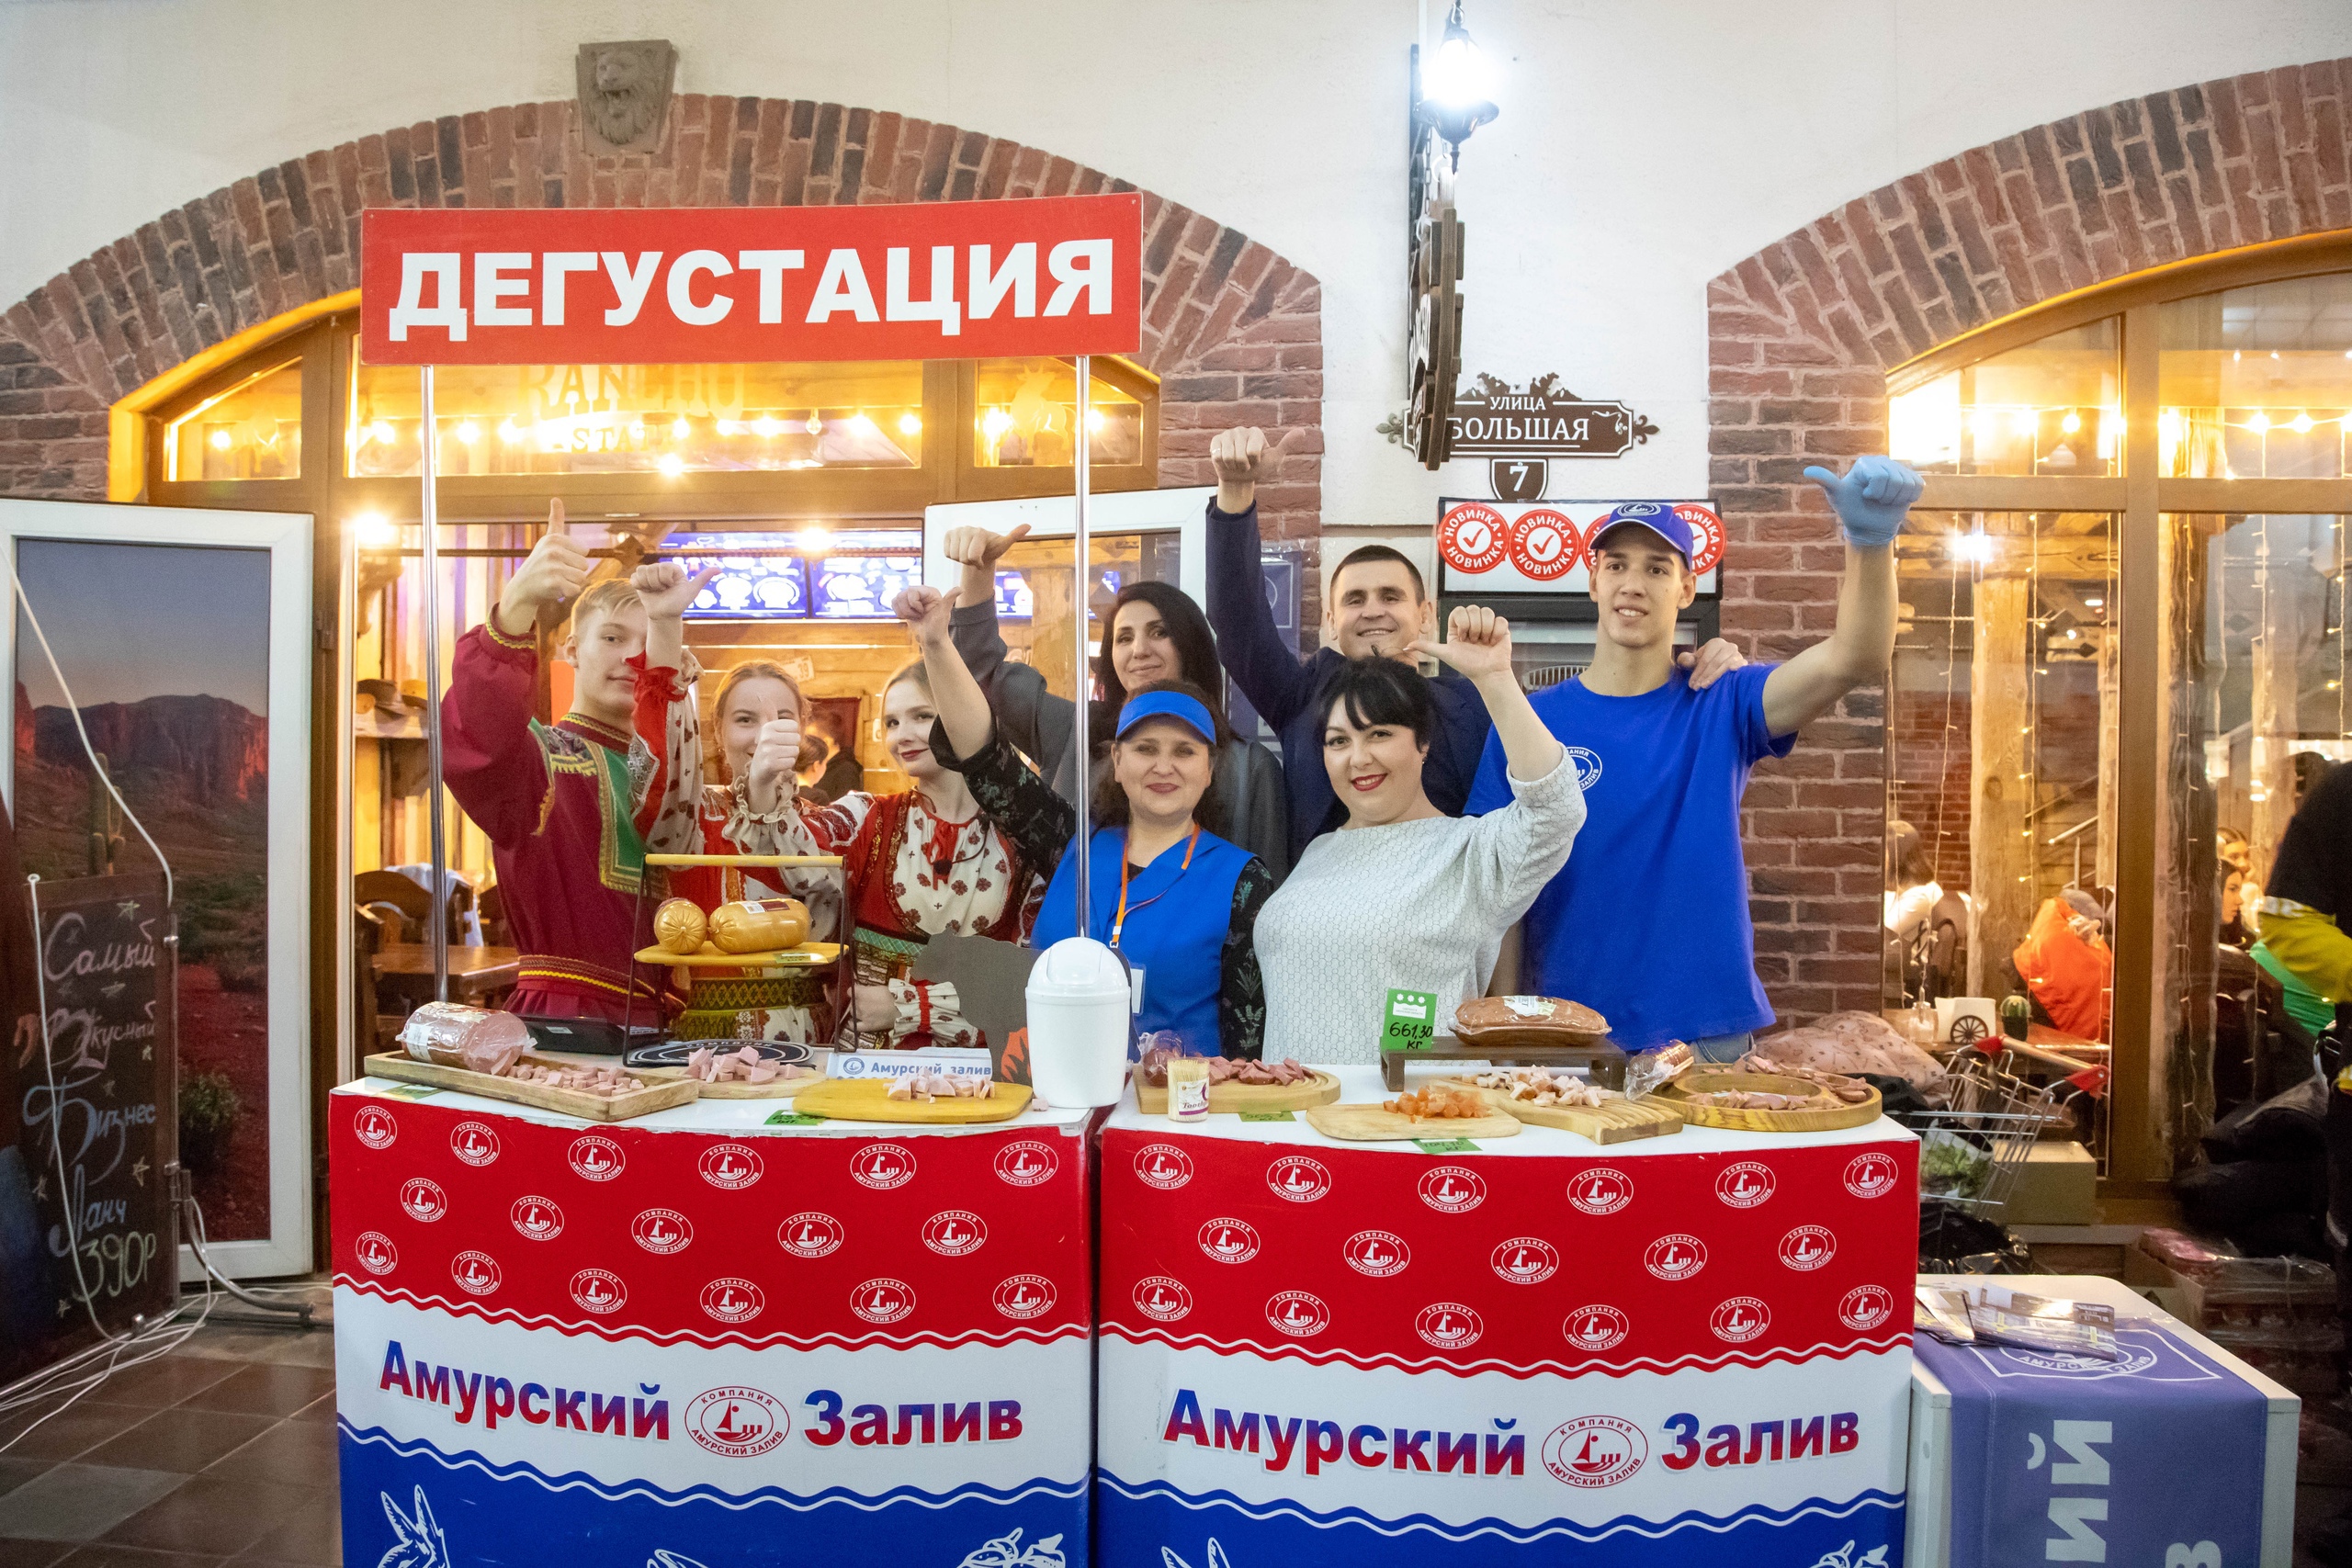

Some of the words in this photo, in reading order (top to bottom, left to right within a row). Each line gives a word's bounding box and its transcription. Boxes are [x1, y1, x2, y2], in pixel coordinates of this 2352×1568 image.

[389, 237, 1113, 343] ДЕГУСТАЦИЯ
[1489, 396, 1546, 412] УЛИЦА
[1451, 417, 1589, 441] БОЛЬШАЯ
[1509, 466, 1529, 492] 7
[1444, 509, 1500, 537] НОВИНКА
[1514, 514, 1571, 543] НОВИНКА
[1675, 510, 1720, 544] ОВИНКА
[1446, 540, 1504, 569] НОВИНКА
[1516, 547, 1574, 575] НОВИНКА
[1579, 769, 1600, 788] ЗАЛИВ
[44, 912, 156, 982] Самый
[950, 1066, 991, 1075] залив
[23, 1073, 157, 1186] Бизнес
[458, 1123, 492, 1137] КОМПАНИЯ
[577, 1137, 616, 1151] КОМПАНИЯ
[708, 1145, 753, 1157] КОМПАНИЯ
[860, 1145, 907, 1157] КОМПАНИЯ
[1003, 1143, 1049, 1155] КОМПАНИЯ
[1143, 1145, 1184, 1159] КОМПАНИЯ
[453, 1145, 481, 1165] АМУРСКИЙ
[481, 1151, 497, 1165] ЗАЛИВ
[1276, 1157, 1321, 1171] КОМПАНИЯ
[571, 1161, 603, 1179] АМУРСКИЙ
[603, 1165, 622, 1179] ЗАЛИВ
[702, 1170, 738, 1188] АМУРСКИЙ
[738, 1171, 760, 1188] ЗАЛИВ
[854, 1172, 890, 1188] АМУРСКИЙ
[890, 1170, 912, 1187] ЗАЛИВ
[998, 1169, 1033, 1185] АМУРСКИЙ
[1033, 1167, 1055, 1183] ЗАЛИВ
[1137, 1169, 1170, 1188] АМУРСКИЙ
[1170, 1173, 1190, 1188] ЗАЛИВ
[1428, 1168, 1476, 1180] КОМПАНИЯ
[1577, 1170, 1623, 1182] КОМПАНИЯ
[1724, 1164, 1767, 1177] КОМПАНИЯ
[1271, 1182, 1306, 1201] АМУРСКИЙ
[1306, 1185, 1328, 1201] ЗАЛИВ
[1719, 1191, 1752, 1206] АМУРСКИЙ
[1752, 1188, 1772, 1205] ЗАЛИВ
[49, 1164, 127, 1258] Ланч
[519, 1197, 556, 1212] КОМПАНИЯ
[1421, 1193, 1459, 1212] АМУРСКИЙ
[1459, 1195, 1482, 1211] ЗАЛИВ
[1571, 1197, 1607, 1213] АМУРСКИЙ
[1608, 1195, 1630, 1212] ЗАЛИВ
[640, 1210, 684, 1223] КОМПАНИЯ
[787, 1214, 834, 1225] КОМПАНИЯ
[932, 1212, 978, 1224] КОМПАНИЯ
[514, 1220, 543, 1239] АМУРСКИЙ
[543, 1225, 560, 1239] ЗАЛИВ
[1207, 1219, 1251, 1233] КОМПАНИЯ
[1787, 1227, 1827, 1240] КОМПАНИЯ
[635, 1235, 669, 1252] АМУРСКИЙ
[669, 1237, 689, 1252] ЗАЛИВ
[782, 1240, 818, 1256] АМУРСКИЙ
[818, 1239, 840, 1256] ЗАЛИВ
[925, 1238, 961, 1255] АМУРСКИЙ
[961, 1236, 983, 1253] ЗАЛИВ
[1353, 1232, 1400, 1246] КОМПАНИЯ
[1501, 1239, 1549, 1251] КОМПАНИЯ
[1654, 1236, 1698, 1249] КОМПАНИЯ
[459, 1252, 494, 1267] КОМПАНИЯ
[1202, 1243, 1236, 1262] АМУРСКИЙ
[1236, 1247, 1257, 1262] ЗАЛИВ
[1781, 1255, 1814, 1269] АМУРСКИЙ
[1814, 1250, 1833, 1268] ЗАЛИВ
[1348, 1257, 1384, 1275] АМУРСКИЙ
[1384, 1259, 1407, 1275] ЗАЛИВ
[1495, 1266, 1532, 1282] АМУРСКИЙ
[1532, 1265, 1555, 1281] ЗАЛИВ
[1648, 1264, 1682, 1279] АМУРСКИЙ
[1682, 1259, 1703, 1277] ЗАЛИВ
[454, 1274, 481, 1293] АМУРСКИЙ
[481, 1280, 498, 1293] ЗАЛИВ
[578, 1270, 618, 1284] КОМПАНИЯ
[709, 1280, 755, 1292] КОМПАНИЯ
[860, 1280, 906, 1292] КОМПАНИЯ
[1002, 1276, 1047, 1289] КОМПАНИЯ
[1142, 1278, 1183, 1292] КОМПАНИЯ
[573, 1293, 605, 1312] АМУРСКИЙ
[605, 1298, 624, 1312] ЗАЛИВ
[1275, 1292, 1320, 1306] КОМПАНИЯ
[1719, 1299, 1762, 1312] КОМПАНИЯ
[704, 1304, 739, 1322] АМУРСКИЙ
[739, 1305, 761, 1321] ЗАЛИВ
[854, 1306, 889, 1322] АМУРСКИЙ
[890, 1304, 911, 1321] ЗАЛИВ
[997, 1303, 1032, 1317] АМУРСКИЙ
[1032, 1300, 1053, 1316] ЗАЛИВ
[1136, 1301, 1169, 1320] АМУРСКИЙ
[1169, 1305, 1189, 1320] ЗАЛИВ
[1426, 1304, 1473, 1317] КОМПАНИЯ
[1573, 1306, 1619, 1319] КОМПАНИЯ
[1269, 1316, 1305, 1335] АМУРСКИЙ
[1305, 1320, 1326, 1335] ЗАЛИВ
[1713, 1326, 1747, 1341] АМУРСКИЙ
[1747, 1322, 1767, 1339] ЗАЛИВ
[1419, 1329, 1456, 1348] АМУРСКИЙ
[1456, 1331, 1479, 1347] ЗАЛИВ
[1566, 1334, 1602, 1349] АМУРСКИЙ
[1603, 1331, 1624, 1348] ЗАЛИВ
[2114, 1355, 2152, 1372] ЗАЛИВ
[379, 1339, 670, 1441] Амурский
[701, 1389, 773, 1406] КОМПАНИЯ
[803, 1389, 1023, 1447] Залив
[1559, 1418, 1633, 1436] КОМПАНИЯ
[1162, 1388, 1526, 1476] Амурский
[1661, 1411, 1860, 1471] Залив
[691, 1429, 748, 1455] АМУРСКИЙ
[750, 1430, 783, 1454] ЗАЛИВ
[1548, 1461, 1605, 1485] АМУРСКИЙ
[1607, 1458, 1641, 1483] ЗАЛИВ
